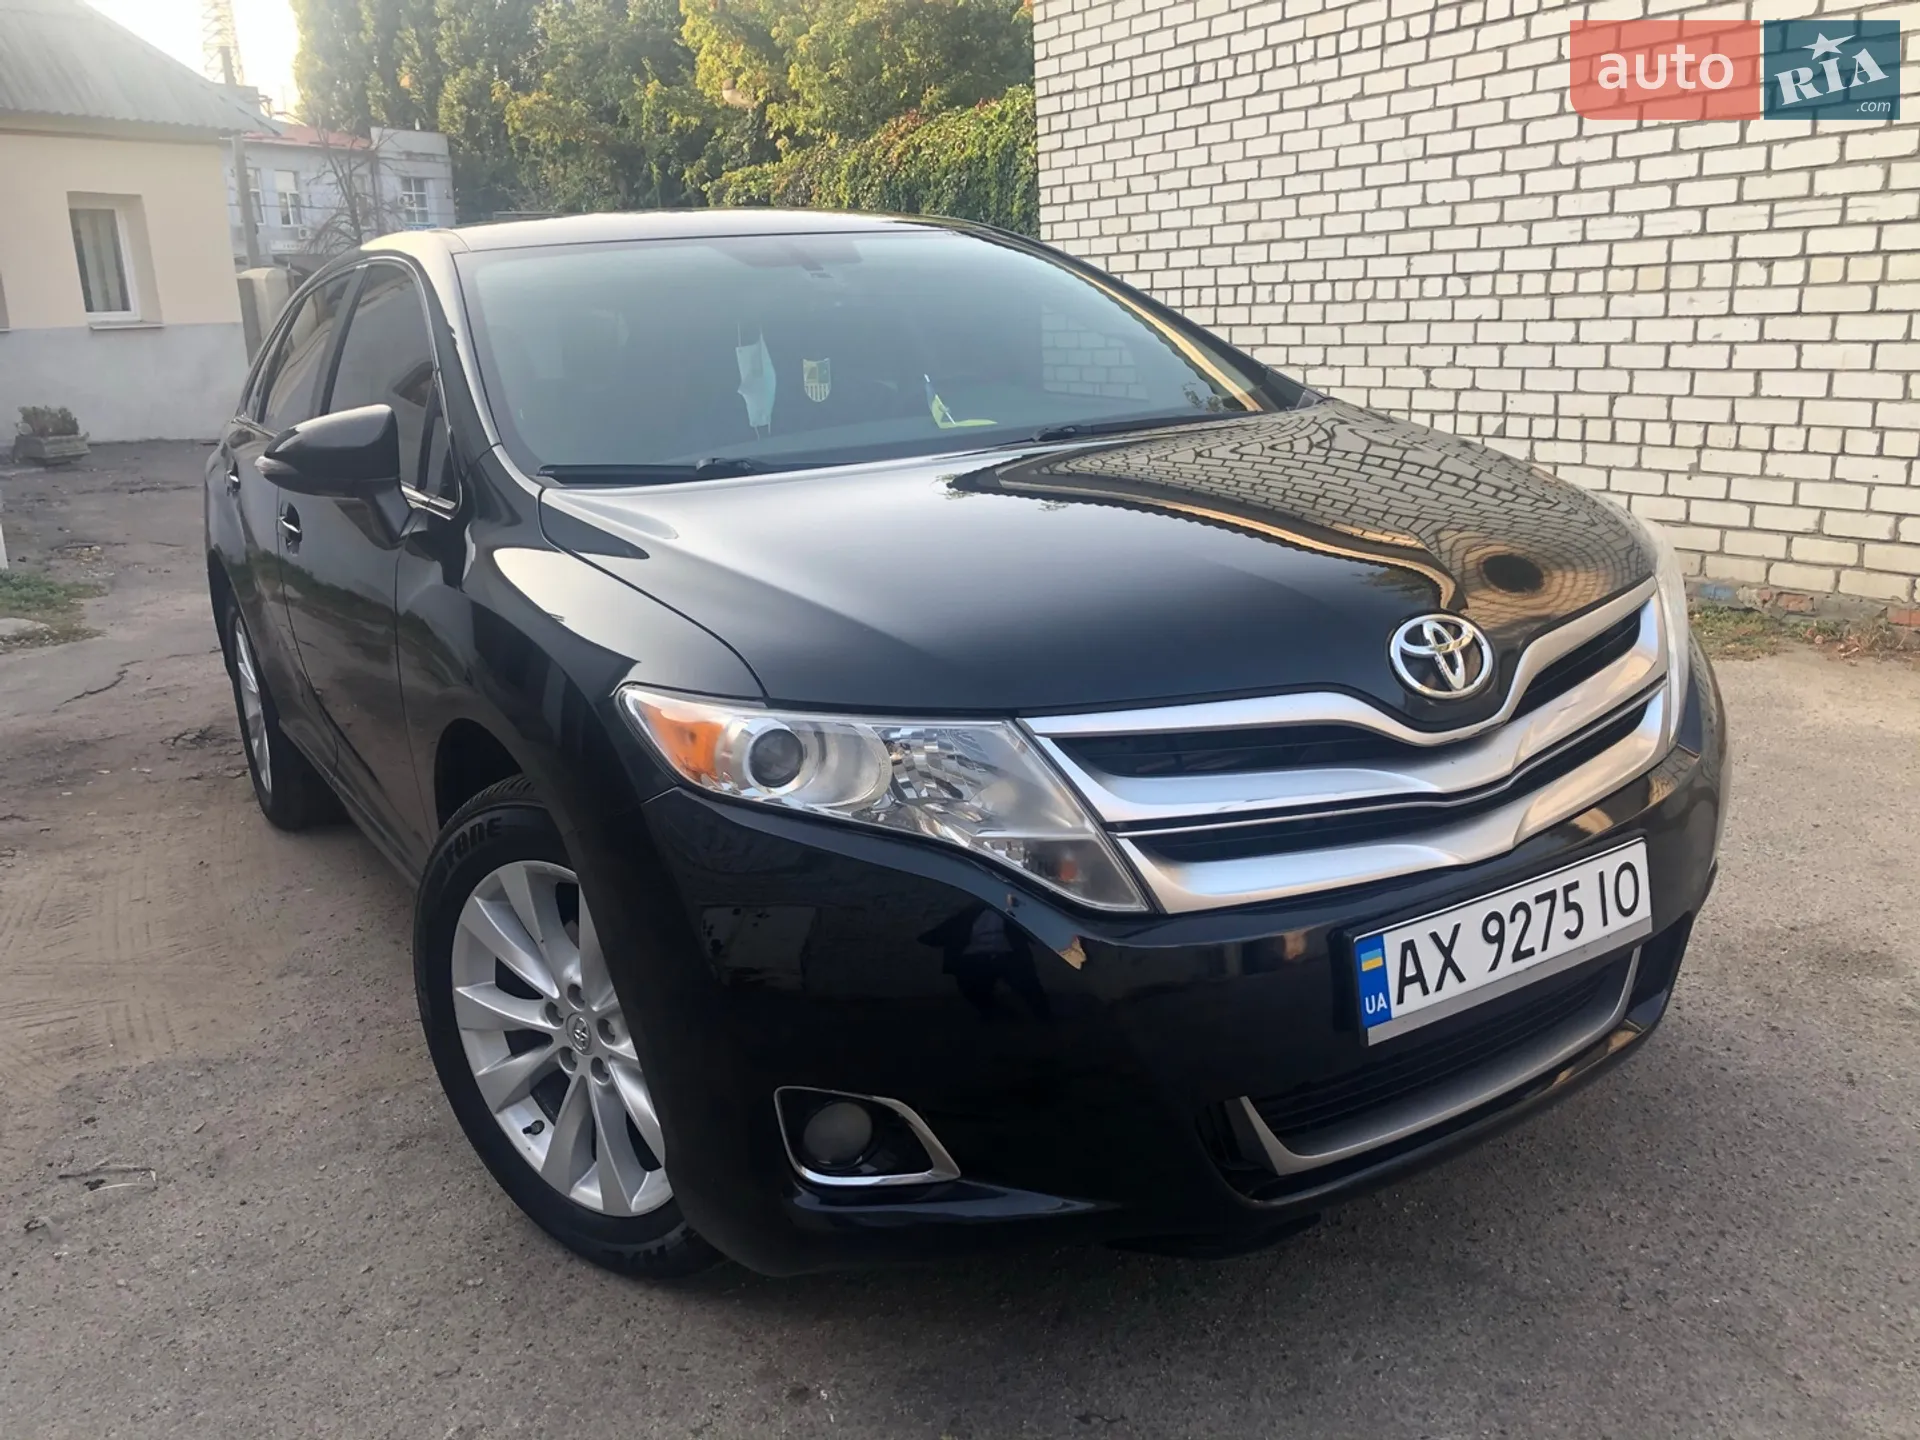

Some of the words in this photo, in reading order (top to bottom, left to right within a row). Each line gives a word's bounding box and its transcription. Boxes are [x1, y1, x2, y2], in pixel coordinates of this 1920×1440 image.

[1396, 922, 1467, 1006] AX
[1481, 880, 1584, 973] 9275
[1598, 861, 1640, 927] IO
[1365, 992, 1388, 1015] UA
